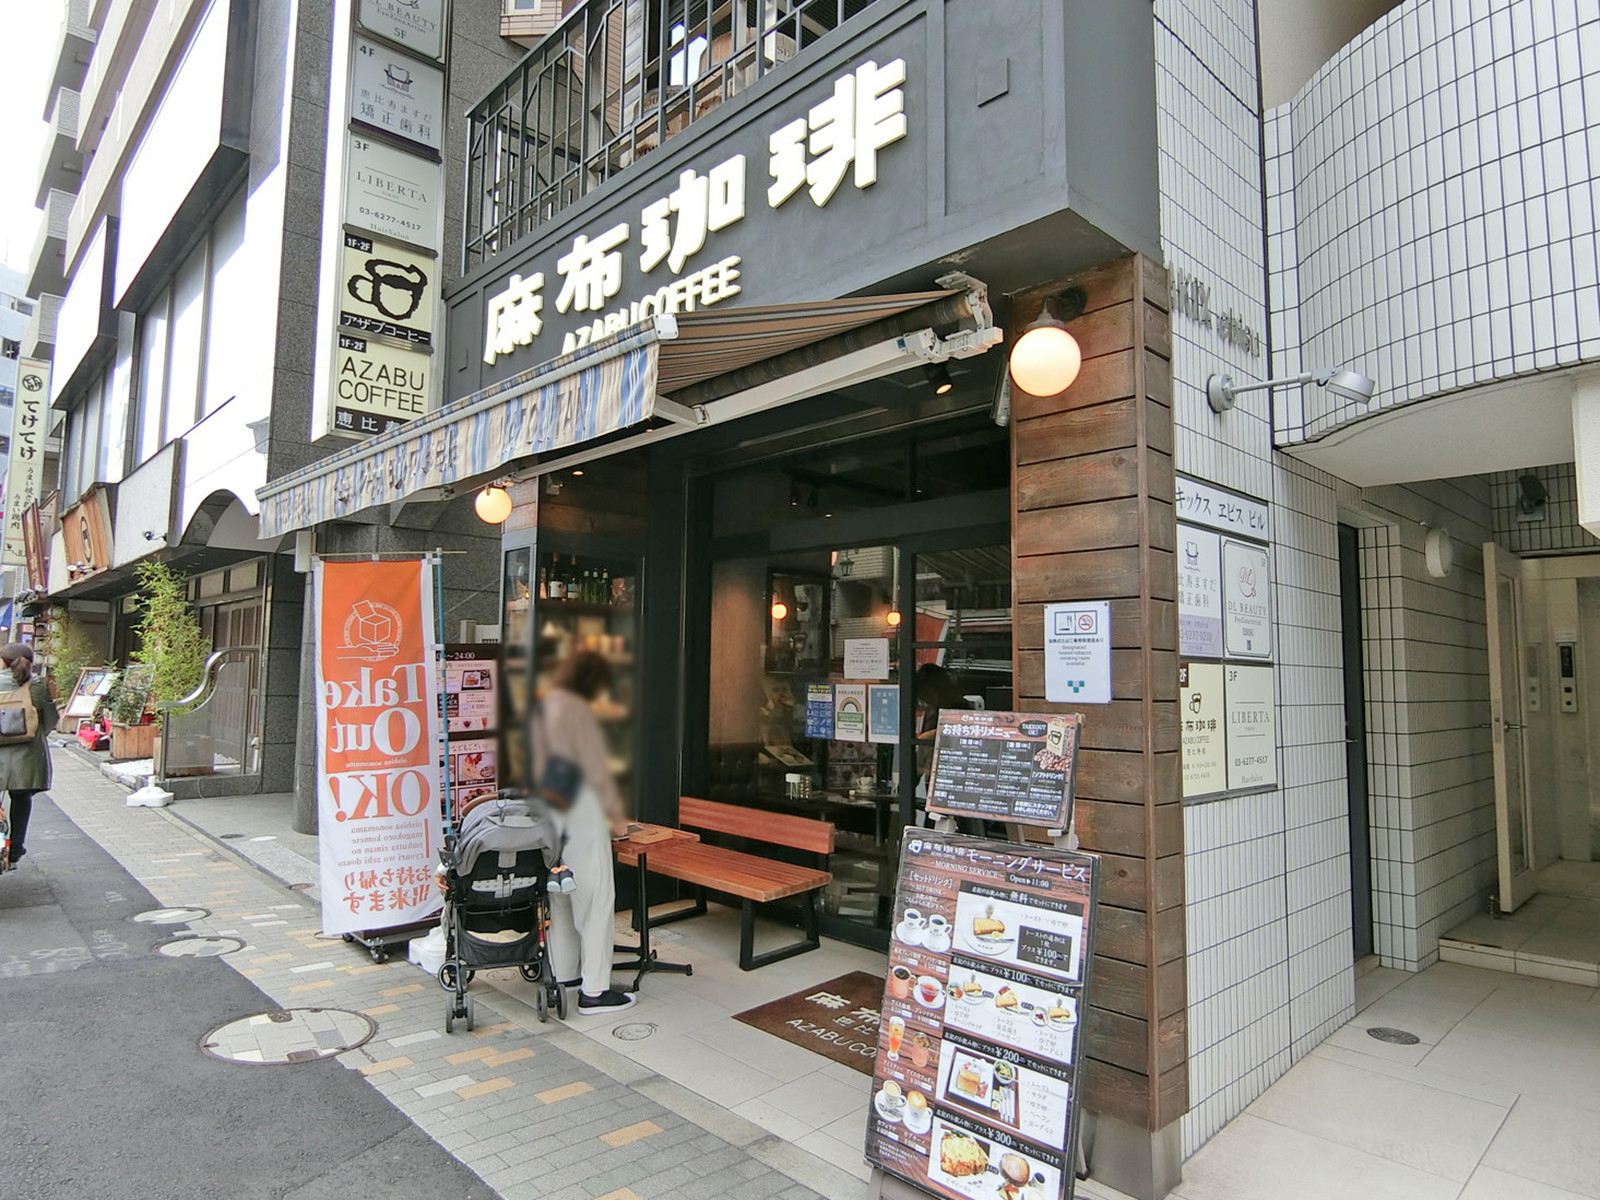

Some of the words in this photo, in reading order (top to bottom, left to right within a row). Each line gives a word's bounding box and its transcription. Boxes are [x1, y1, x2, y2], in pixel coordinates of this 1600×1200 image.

[388, 3, 437, 30] BEAUTY
[394, 28, 407, 39] 5F
[360, 45, 375, 57] 4F
[360, 101, 431, 138] 矯正歯科
[354, 140, 369, 151] 3F
[357, 171, 427, 203] LIBERTA
[359, 206, 421, 231] 03-6277-4517
[483, 58, 908, 365] 麻布珈琲
[639, 255, 742, 317] COFFEE
[343, 314, 429, 342] アザブコーヒー
[341, 356, 424, 390] AZABU
[338, 379, 424, 414] COFFEE
[19, 399, 40, 461] てけてけ
[1249, 510, 1265, 530] ビル
[1229, 671, 1237, 682] 3F
[943, 724, 1017, 738] お持ち帰りメニュー
[1231, 711, 1270, 724] LIBERTA
[923, 842, 965, 856] 麻布珈琲
[967, 848, 1087, 882] モーニングサービス
[1010, 874, 1026, 884] Open
[1031, 878, 1050, 888] 11:00
[785, 1019, 849, 1046] AZABU
